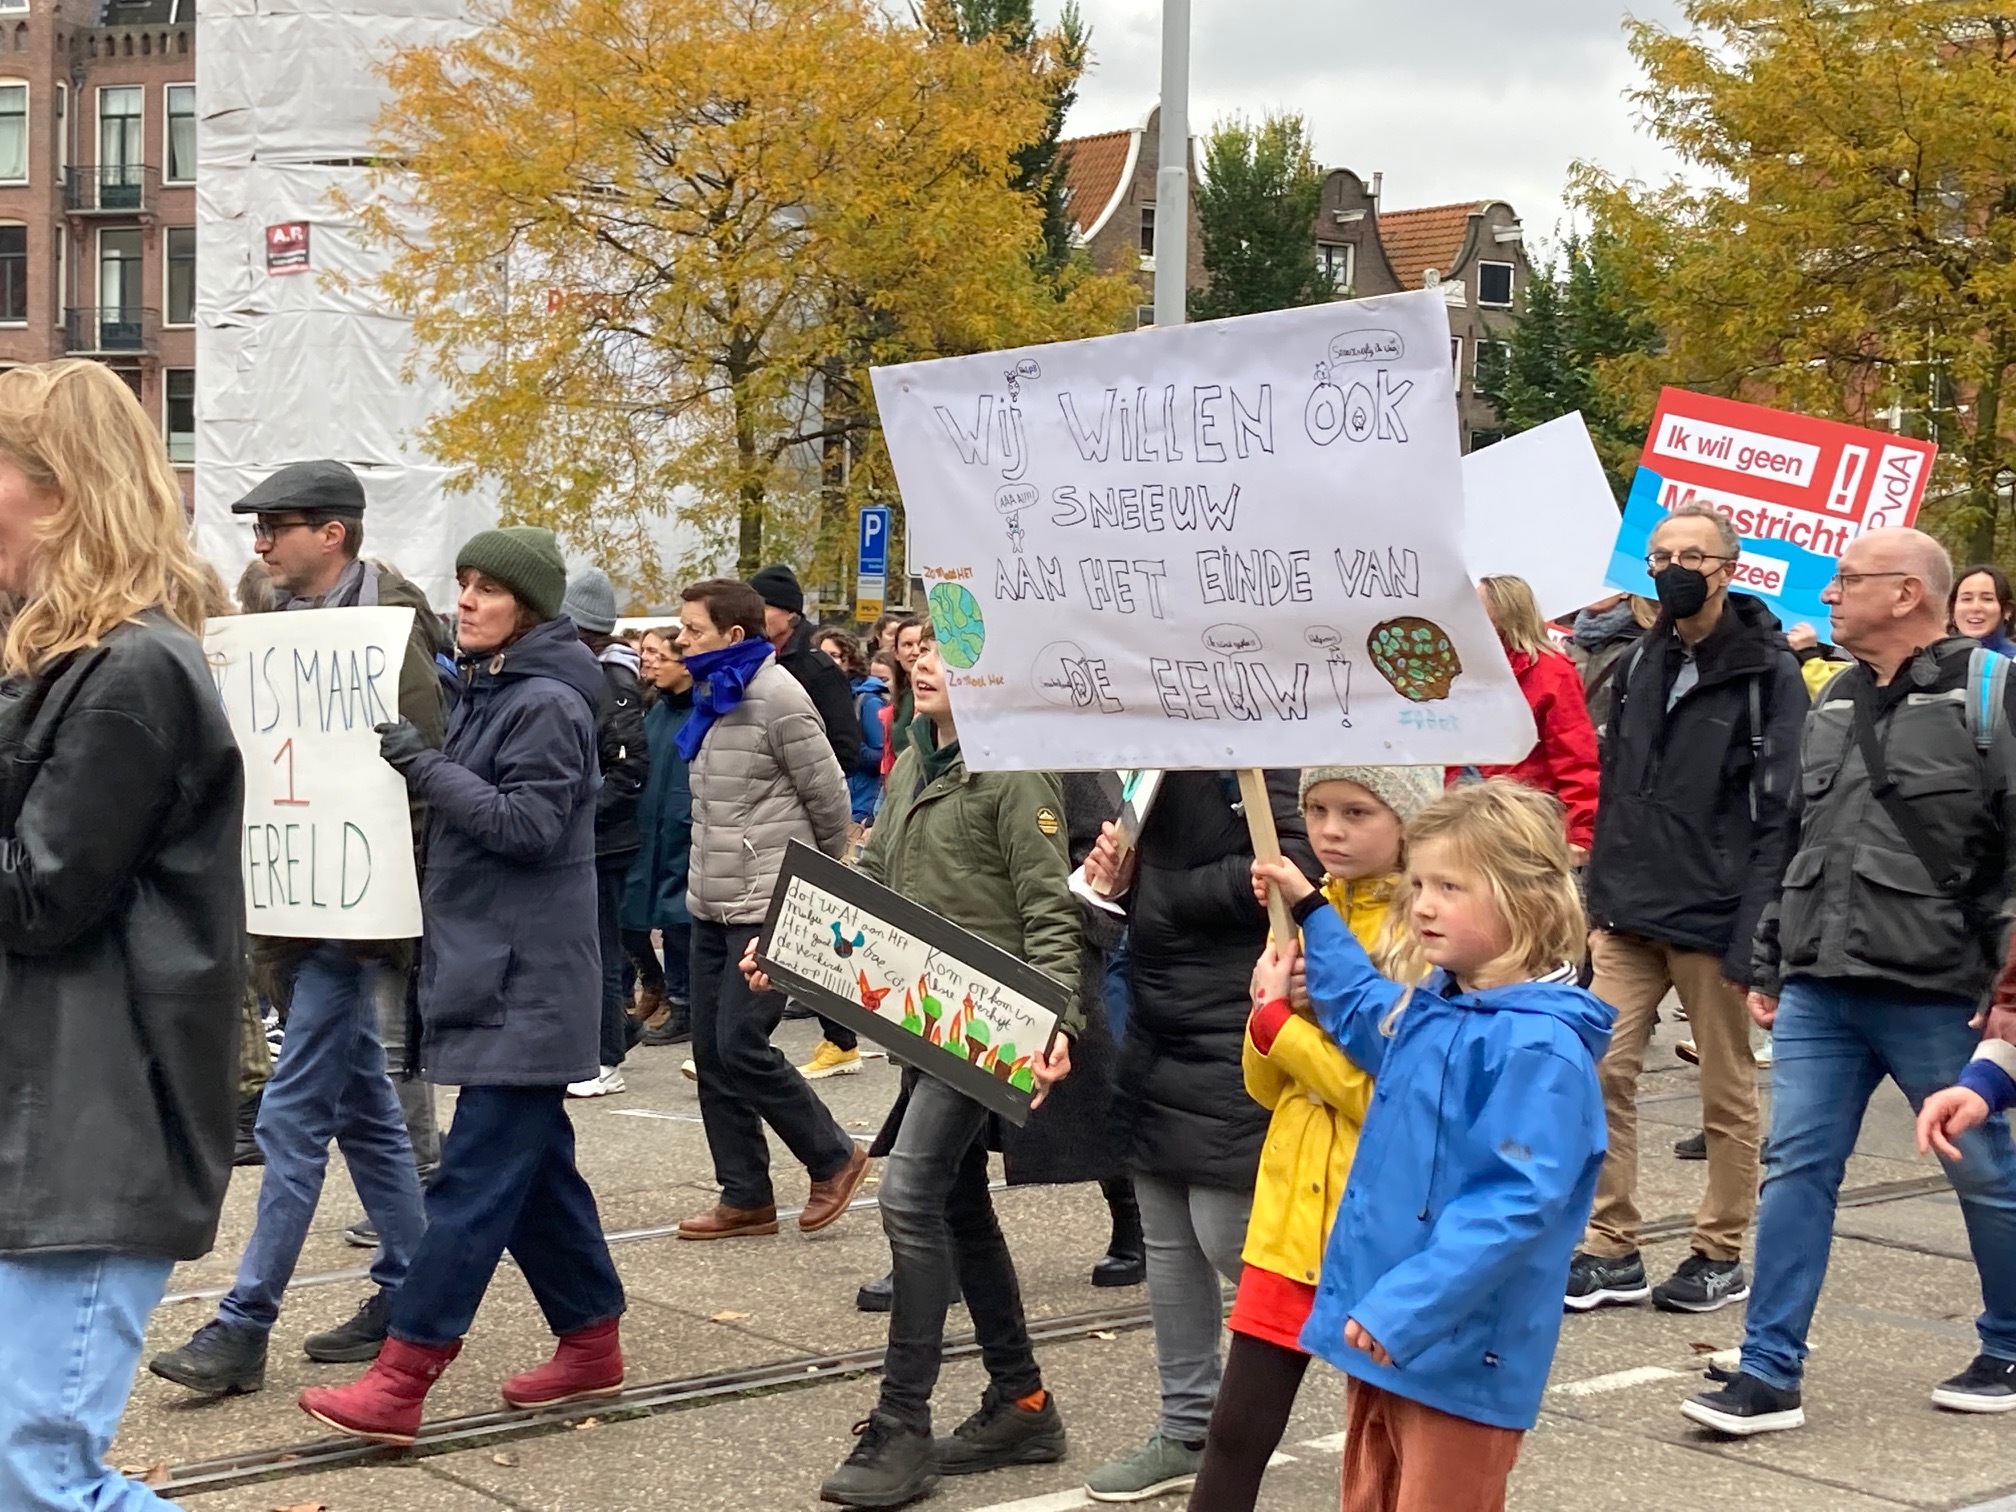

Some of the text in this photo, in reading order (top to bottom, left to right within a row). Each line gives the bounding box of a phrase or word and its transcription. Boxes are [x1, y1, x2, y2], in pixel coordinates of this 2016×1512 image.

[1304, 369, 1414, 446] OOK
[1666, 424, 1803, 476] Ik wil geen
[1835, 453, 1861, 507] !
[1051, 483, 1241, 532] SNEEUW
[1867, 455, 1918, 530] PvdA
[865, 514, 882, 548] P
[995, 556, 1067, 600] AAN
[1078, 558, 1167, 619] HET
[1334, 546, 1420, 599] VAN
[1732, 563, 1780, 589] zee
[249, 646, 280, 733] IS
[293, 645, 393, 733] MAAR
[1061, 657, 1125, 714] DE
[273, 737, 310, 808] 1
[244, 821, 372, 910] ERELD
